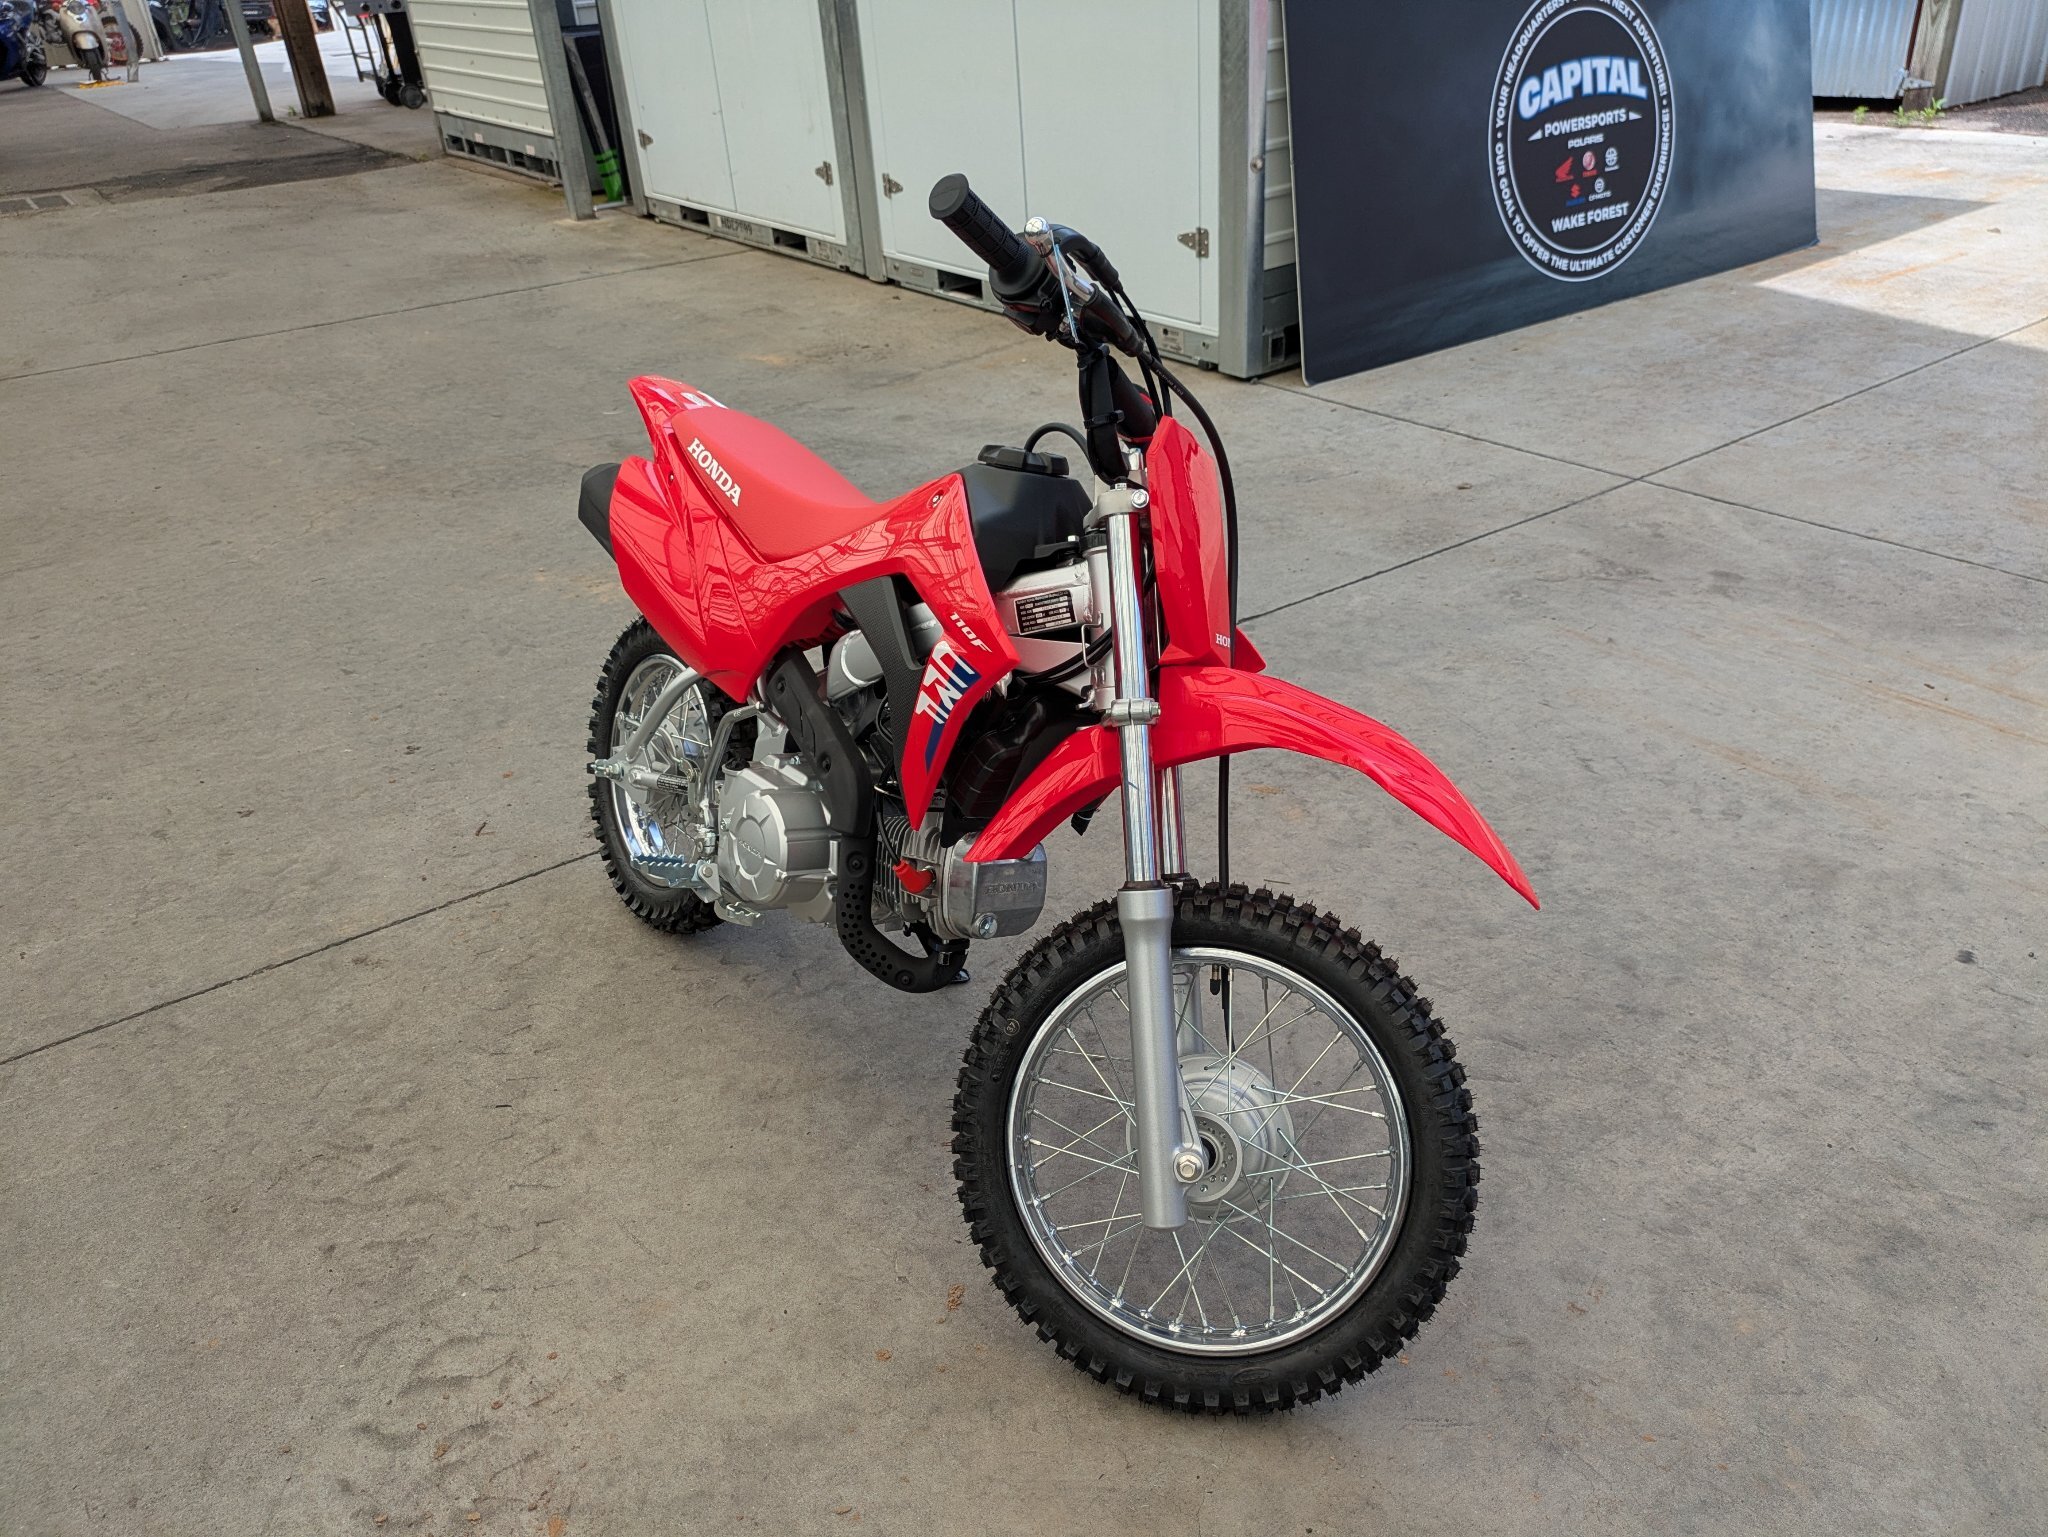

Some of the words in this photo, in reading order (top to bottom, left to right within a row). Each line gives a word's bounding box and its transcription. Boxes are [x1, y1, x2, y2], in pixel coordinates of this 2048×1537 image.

[1496, 85, 1510, 128] YOUR
[1504, 0, 1566, 84] HEADQUARTERS
[1611, 0, 1635, 21] NEXT
[1633, 18, 1668, 96] ADVENTURE!
[1518, 56, 1648, 119] CAPITAL
[1544, 108, 1627, 138] POWERSPORTS
[1567, 133, 1604, 149] POLARIS
[1650, 108, 1670, 199] EXPERIENCE!
[1495, 142, 1506, 176] OUR
[1500, 177, 1516, 218] GOAL
[1512, 214, 1525, 234] TO
[1551, 212, 1586, 233] WAKE
[1587, 202, 1629, 224] FOREST
[1615, 198, 1655, 255] CUSTOMER
[1522, 231, 1550, 263] OFFER
[1551, 255, 1568, 271] THE
[1569, 248, 1615, 272] ULTIMATE
[687, 438, 742, 507] HONDA
[950, 611, 993, 653] 110F
[1006, 1021, 1017, 1034] 37
